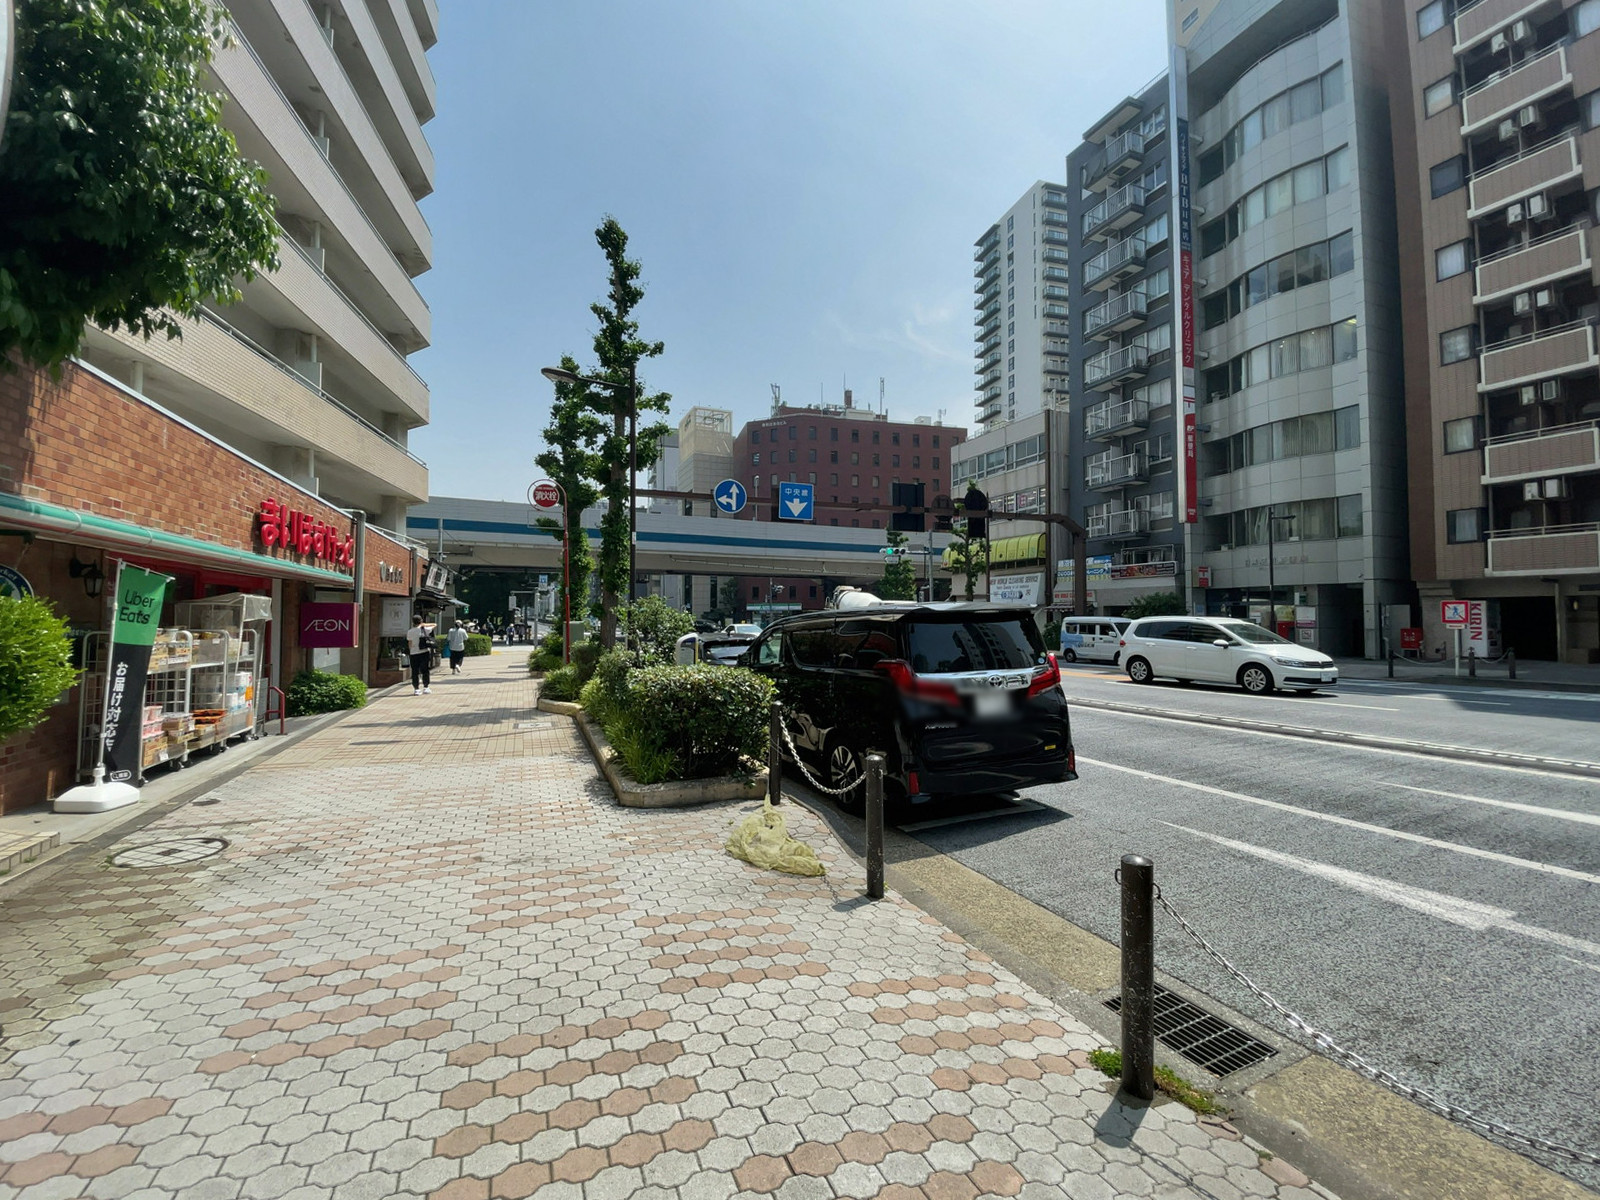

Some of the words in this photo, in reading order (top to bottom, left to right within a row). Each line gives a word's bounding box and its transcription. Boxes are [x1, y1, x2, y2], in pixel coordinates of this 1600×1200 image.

[534, 490, 557, 501] 消火栓
[784, 487, 809, 497] 中央線
[260, 496, 354, 569] まいばすけっと
[124, 589, 155, 609] Uber
[118, 606, 151, 625] Eats
[1470, 602, 1483, 641] KIRIN
